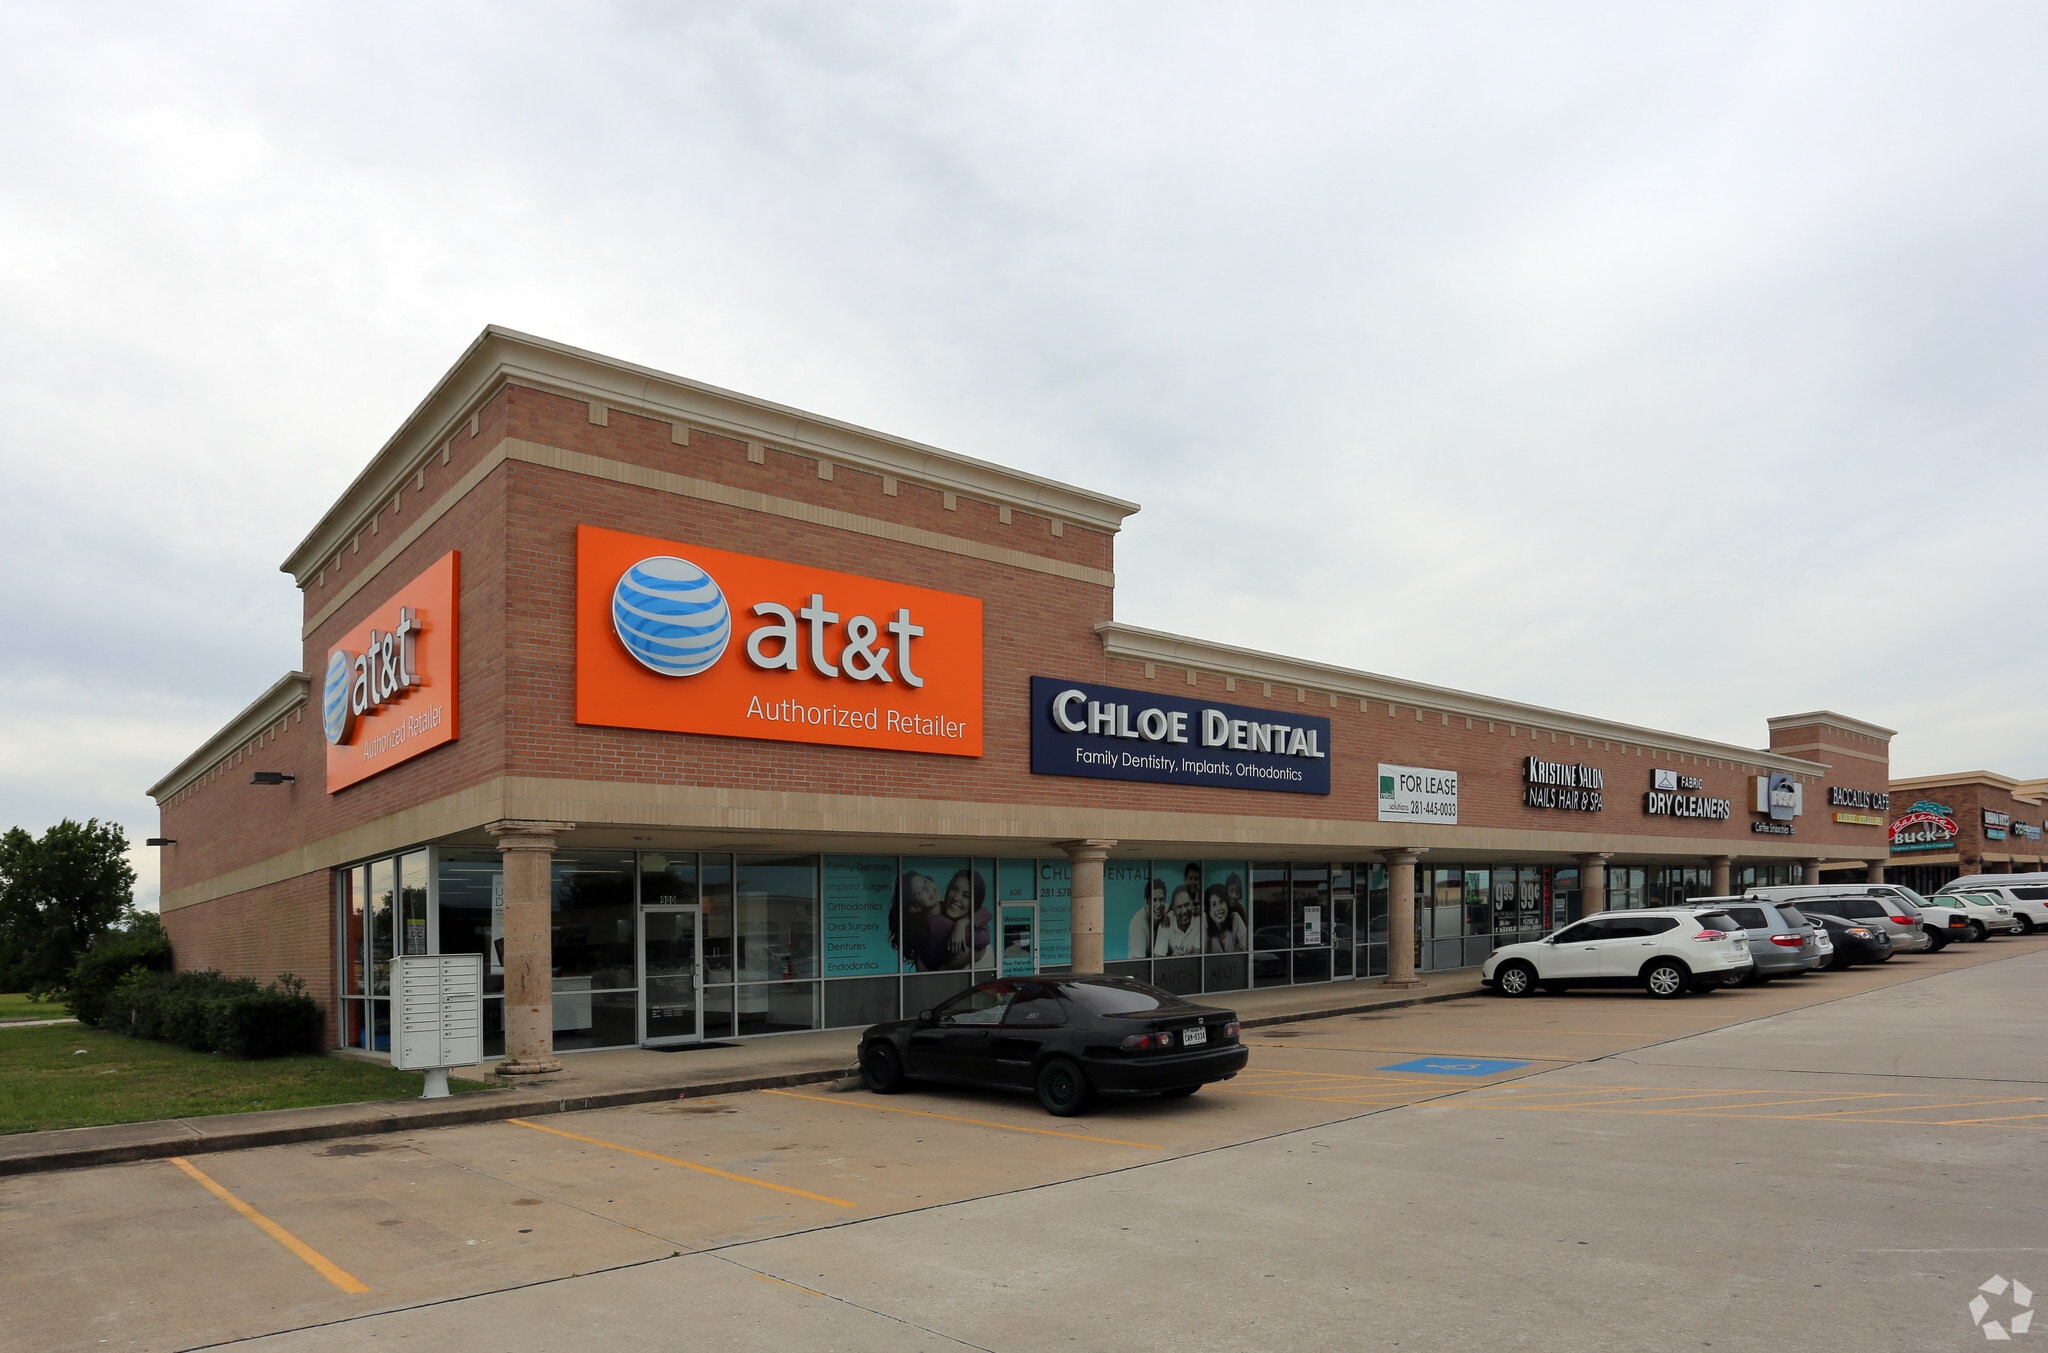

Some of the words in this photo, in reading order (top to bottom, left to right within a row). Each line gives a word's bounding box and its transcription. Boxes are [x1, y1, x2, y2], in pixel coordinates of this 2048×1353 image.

[744, 593, 924, 690] at&t
[352, 606, 418, 716] at&t
[746, 695, 879, 733] Authorized
[885, 709, 967, 740] Retailer
[1052, 689, 1189, 744] CHLOE
[1201, 708, 1326, 759] DENTAL
[364, 719, 406, 760] Authorized
[408, 704, 443, 737] Retailer
[1076, 747, 1119, 770] Family
[1121, 752, 1179, 774] Dentistry,
[1181, 757, 1234, 777] Implants,
[1235, 762, 1303, 782] Orthodontics
[1529, 756, 1577, 787] KRISTINE
[1579, 762, 1604, 790] SALON
[1400, 774, 1422, 793] FOR
[1425, 776, 1456, 796] LEASE
[1681, 776, 1703, 790] FABRIC
[1380, 790, 1394, 799] retail
[1529, 786, 1556, 808] NAILS
[1558, 789, 1579, 810] HAIR
[1581, 791, 1588, 811] &
[1590, 791, 1603, 811] SPA
[1873, 792, 1890, 810] CAFE
[1389, 801, 1409, 811] solutions
[1410, 800, 1457, 817] 281-445-0033
[1649, 792, 1674, 815] DRY
[1674, 794, 1730, 819] CLEANERS
[1755, 822, 1769, 833] Coffee
[1893, 814, 1952, 833] Bahama
[827, 862, 855, 873] Family
[856, 862, 893, 873] Dentistry
[1040, 864, 1071, 881] CHL
[827, 882, 860, 893] Implant
[862, 882, 893, 893] Surgery
[660, 895, 677, 905] 900
[827, 902, 884, 912] Orthodontics
[828, 922, 847, 932] Oral
[848, 922, 880, 933] Surgery
[1040, 927, 1067, 936] Payment
[827, 942, 866, 952] Dentures
[827, 960, 879, 972] Endodontics
